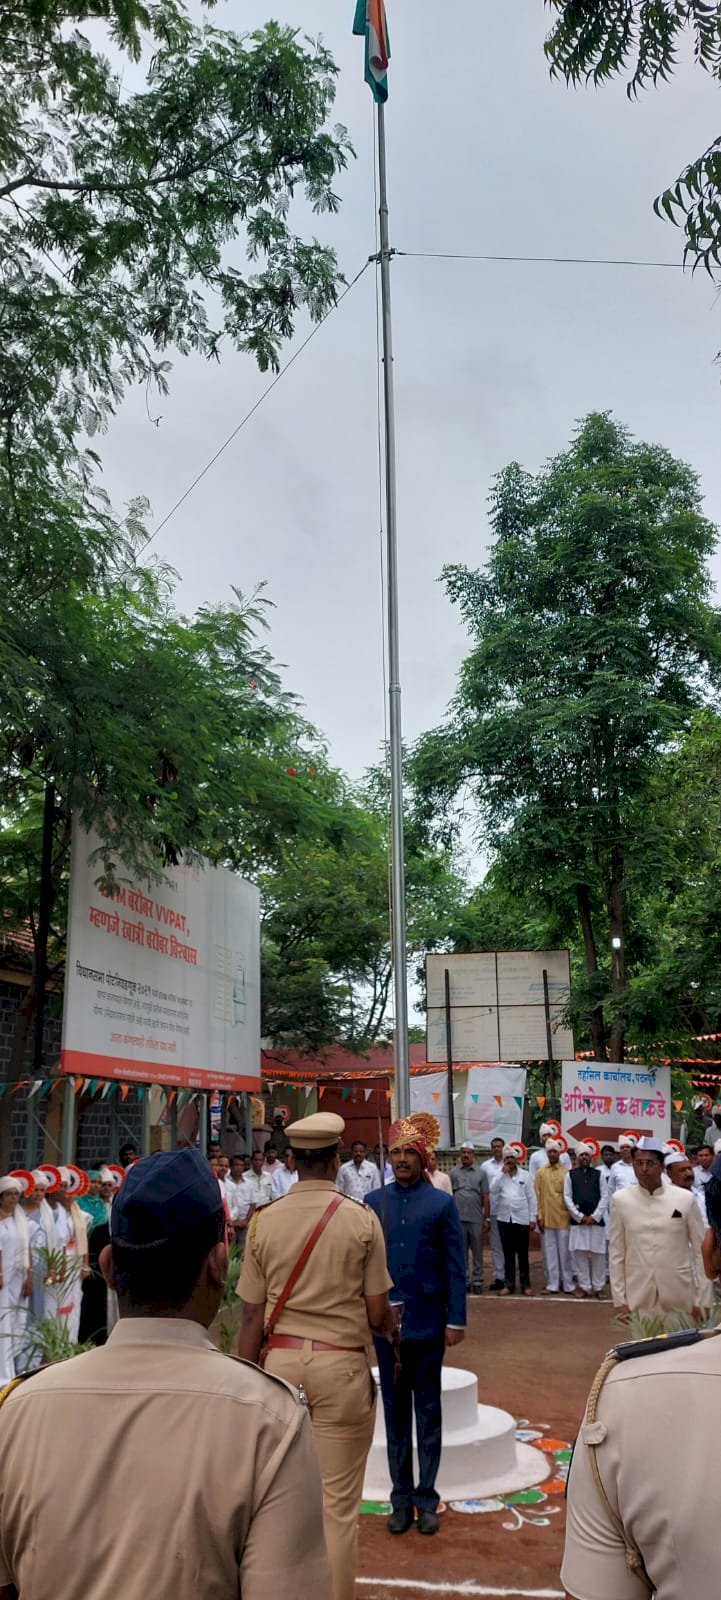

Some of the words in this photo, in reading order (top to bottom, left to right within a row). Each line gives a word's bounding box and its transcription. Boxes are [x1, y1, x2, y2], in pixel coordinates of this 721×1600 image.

[127, 886, 154, 918] बरोबर
[89, 906, 120, 936] म्हणजे
[121, 919, 145, 946] खात्री
[146, 927, 169, 954] बरोबर
[170, 934, 198, 965] विश्वास
[577, 1066, 601, 1082] तहसिल
[564, 1085, 612, 1114] अभिलेख
[615, 1090, 667, 1120] कक्षाकडे
